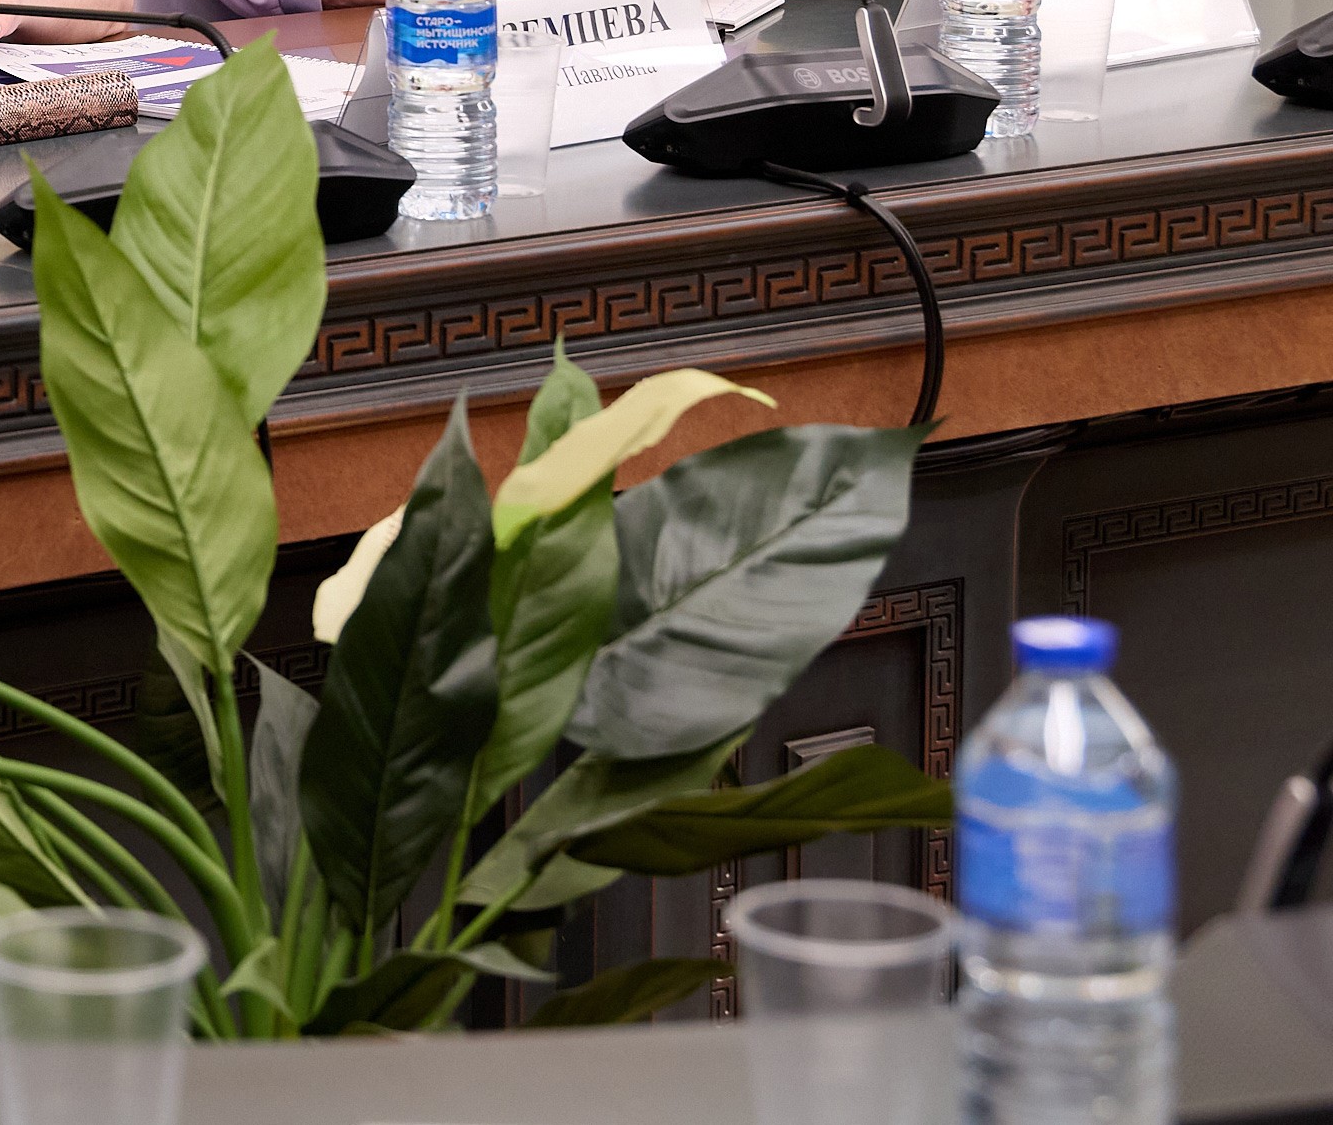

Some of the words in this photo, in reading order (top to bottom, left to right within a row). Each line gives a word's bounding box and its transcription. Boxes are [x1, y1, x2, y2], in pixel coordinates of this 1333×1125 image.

[416, 23, 496, 38] МЫТИЩИНСКИ
[416, 38, 478, 49] ИСТОЧНИК
[561, 62, 658, 87] Павловна
[826, 66, 871, 84] BOS
